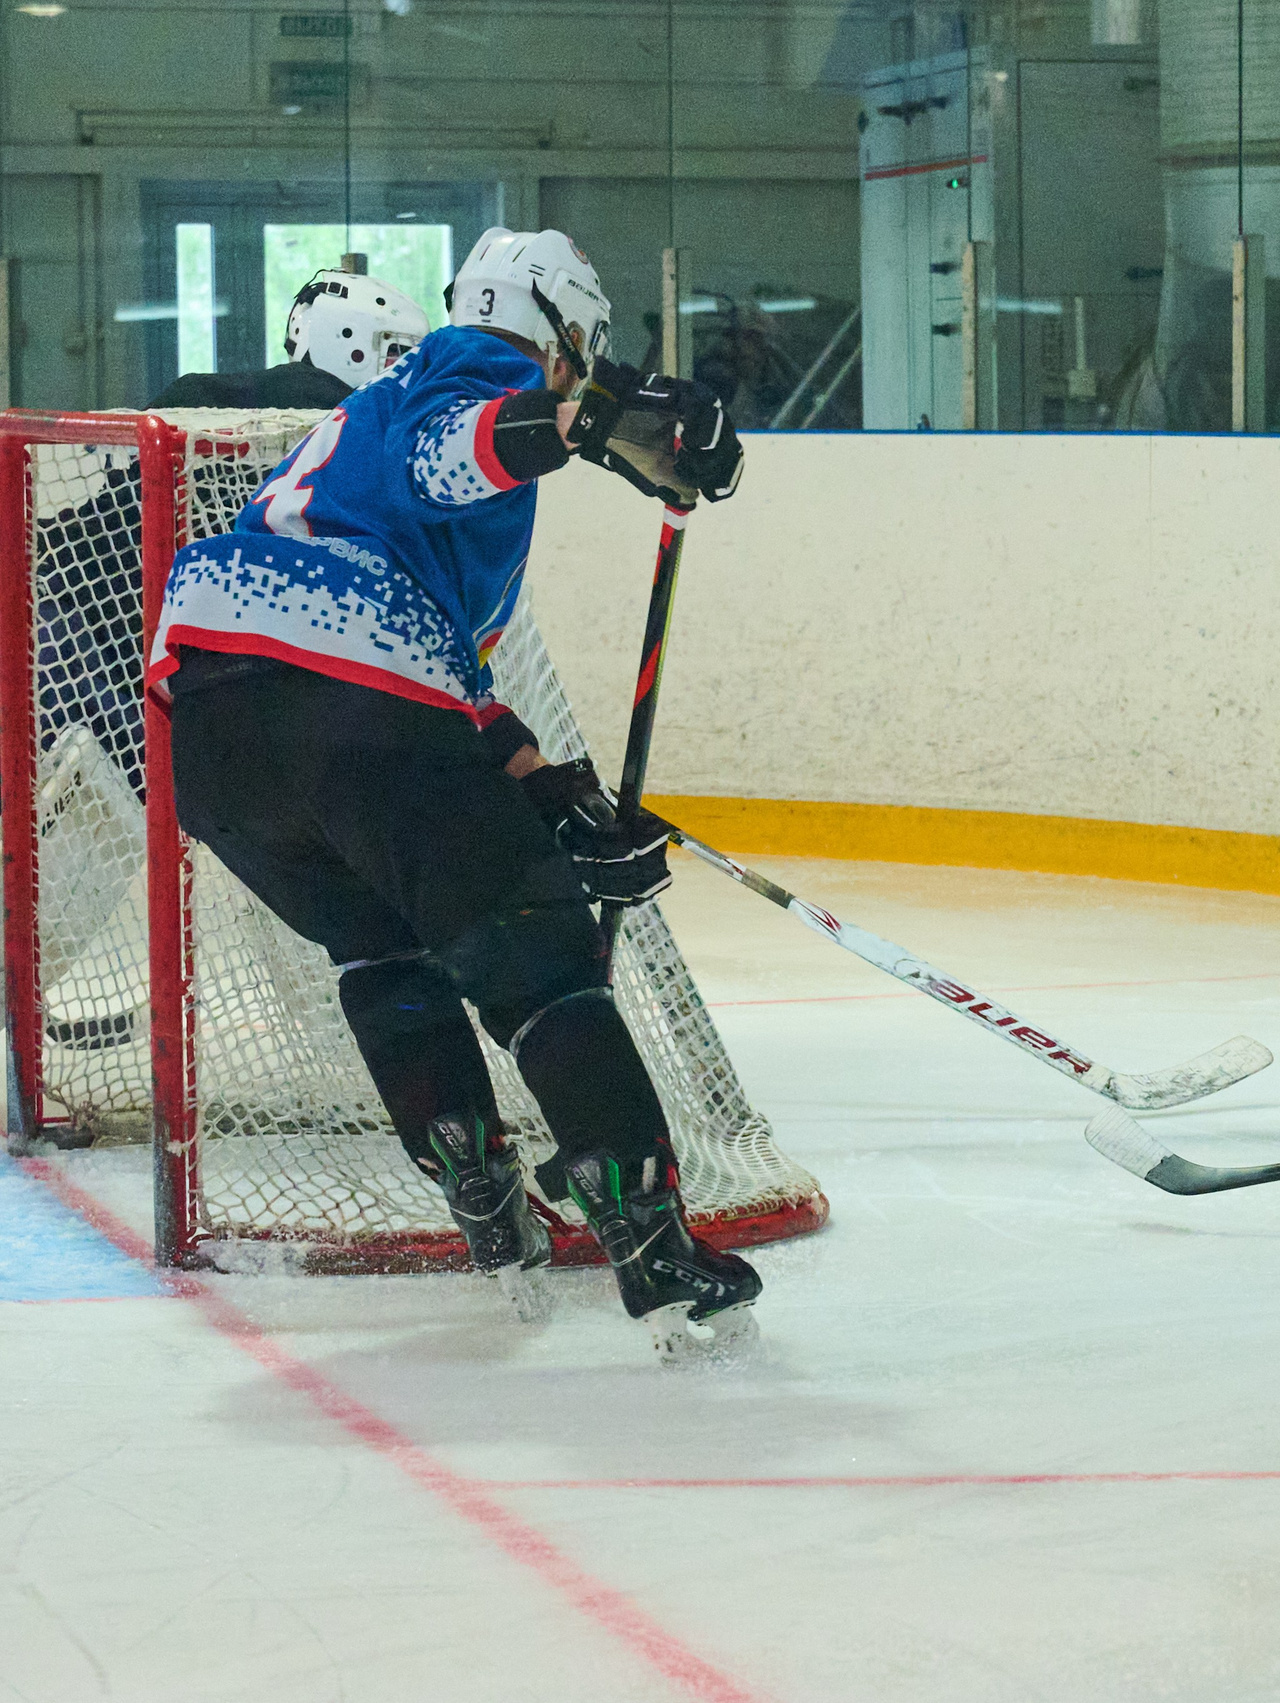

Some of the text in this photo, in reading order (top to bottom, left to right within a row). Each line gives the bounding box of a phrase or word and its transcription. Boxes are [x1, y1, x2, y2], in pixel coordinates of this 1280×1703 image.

[479, 288, 495, 316] 3
[567, 279, 600, 302] BAUER
[928, 977, 1093, 1075] AUER
